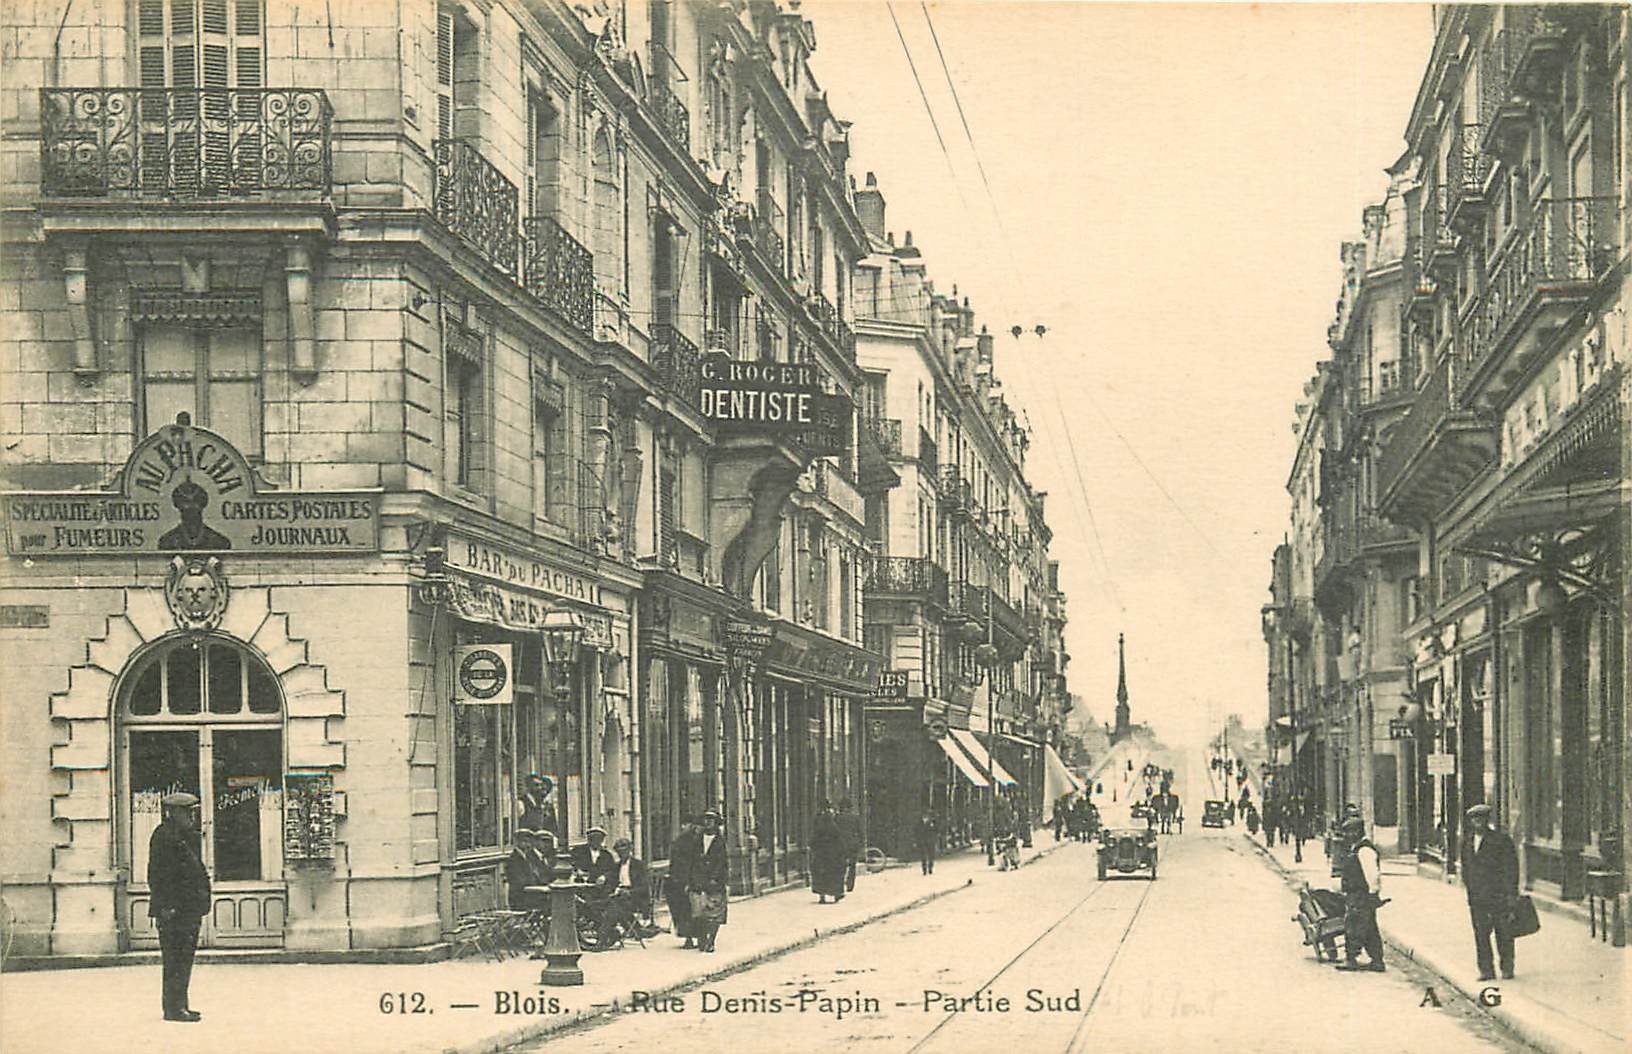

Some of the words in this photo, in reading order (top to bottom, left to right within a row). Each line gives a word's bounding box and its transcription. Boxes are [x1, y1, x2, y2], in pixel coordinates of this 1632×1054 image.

[730, 363, 811, 385] ROGER
[701, 389, 812, 423] DENTISTE
[136, 460, 166, 493] AU
[222, 500, 289, 520] CARTES
[289, 500, 372, 523] POSTALES
[50, 526, 145, 550] FUMEURS
[251, 525, 350, 546] JOURNAUX
[466, 543, 503, 577] BAR
[508, 565, 527, 582] DU
[531, 563, 585, 598] PACHA
